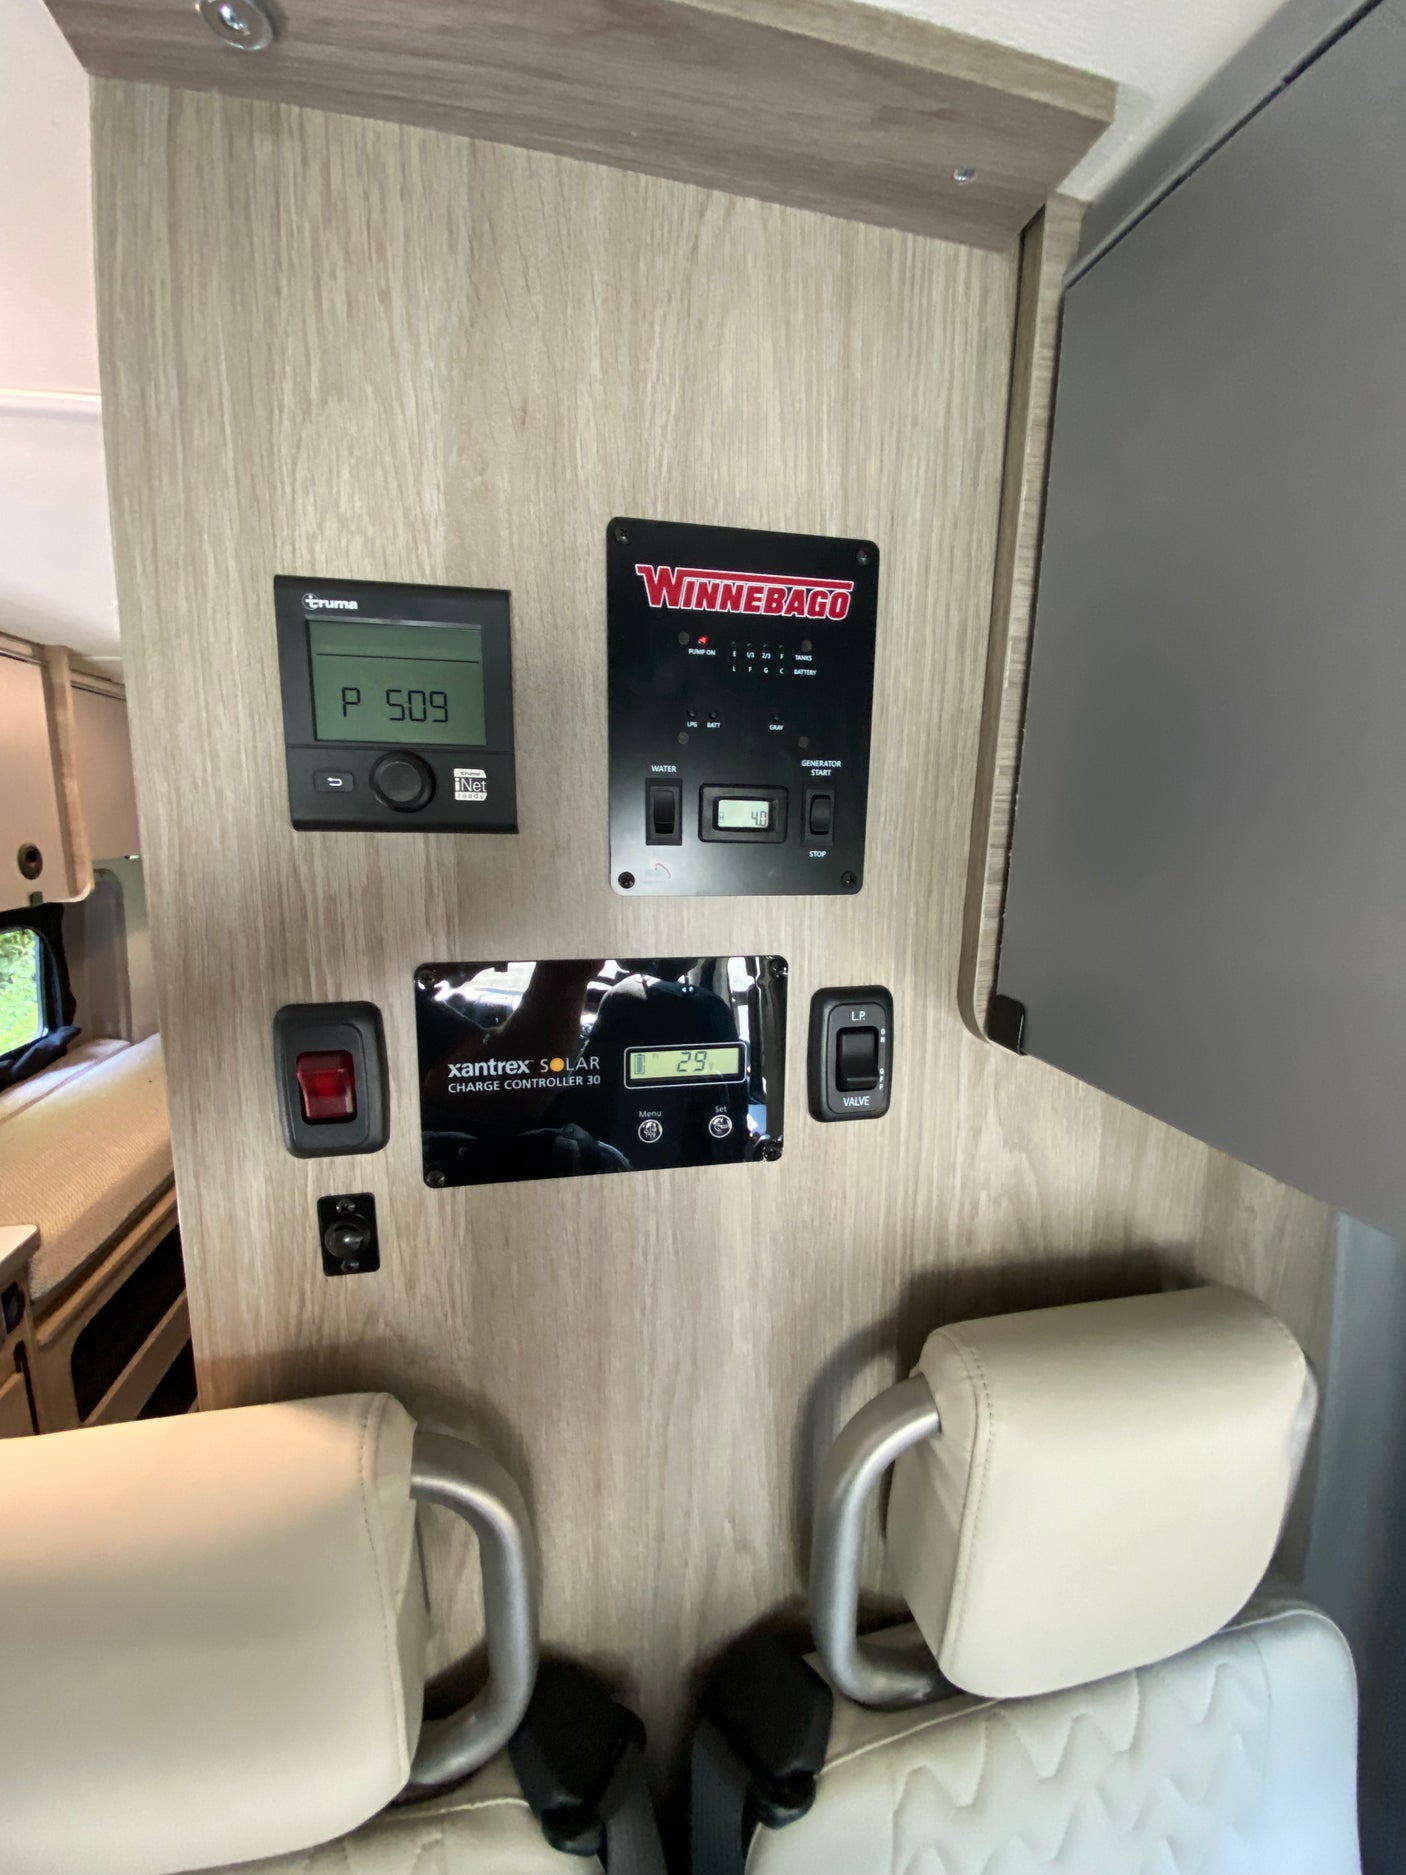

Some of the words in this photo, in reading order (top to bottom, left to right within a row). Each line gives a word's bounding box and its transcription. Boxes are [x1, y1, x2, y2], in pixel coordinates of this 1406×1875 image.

[635, 564, 854, 620] WINNEBAGO
[302, 593, 358, 610] truma
[688, 648, 706, 656] PUMP
[794, 654, 813, 662] TANKS
[793, 668, 817, 676] BATTERY
[341, 687, 361, 718] P
[386, 688, 449, 723] 509
[801, 759, 842, 768] GENERATOR
[651, 765, 677, 773] WATER
[810, 769, 832, 777] START
[454, 777, 487, 792] iNet
[809, 850, 827, 858] STOP
[447, 1058, 531, 1078] xantrex
[540, 1056, 600, 1073] SOLAR
[448, 1080, 501, 1093] CHARGE
[504, 1075, 584, 1090] CONTROLLER
[587, 1074, 601, 1085] 30
[843, 1095, 870, 1107] VALVE
[714, 1105, 727, 1113] Set
[638, 1110, 662, 1118] Menu
